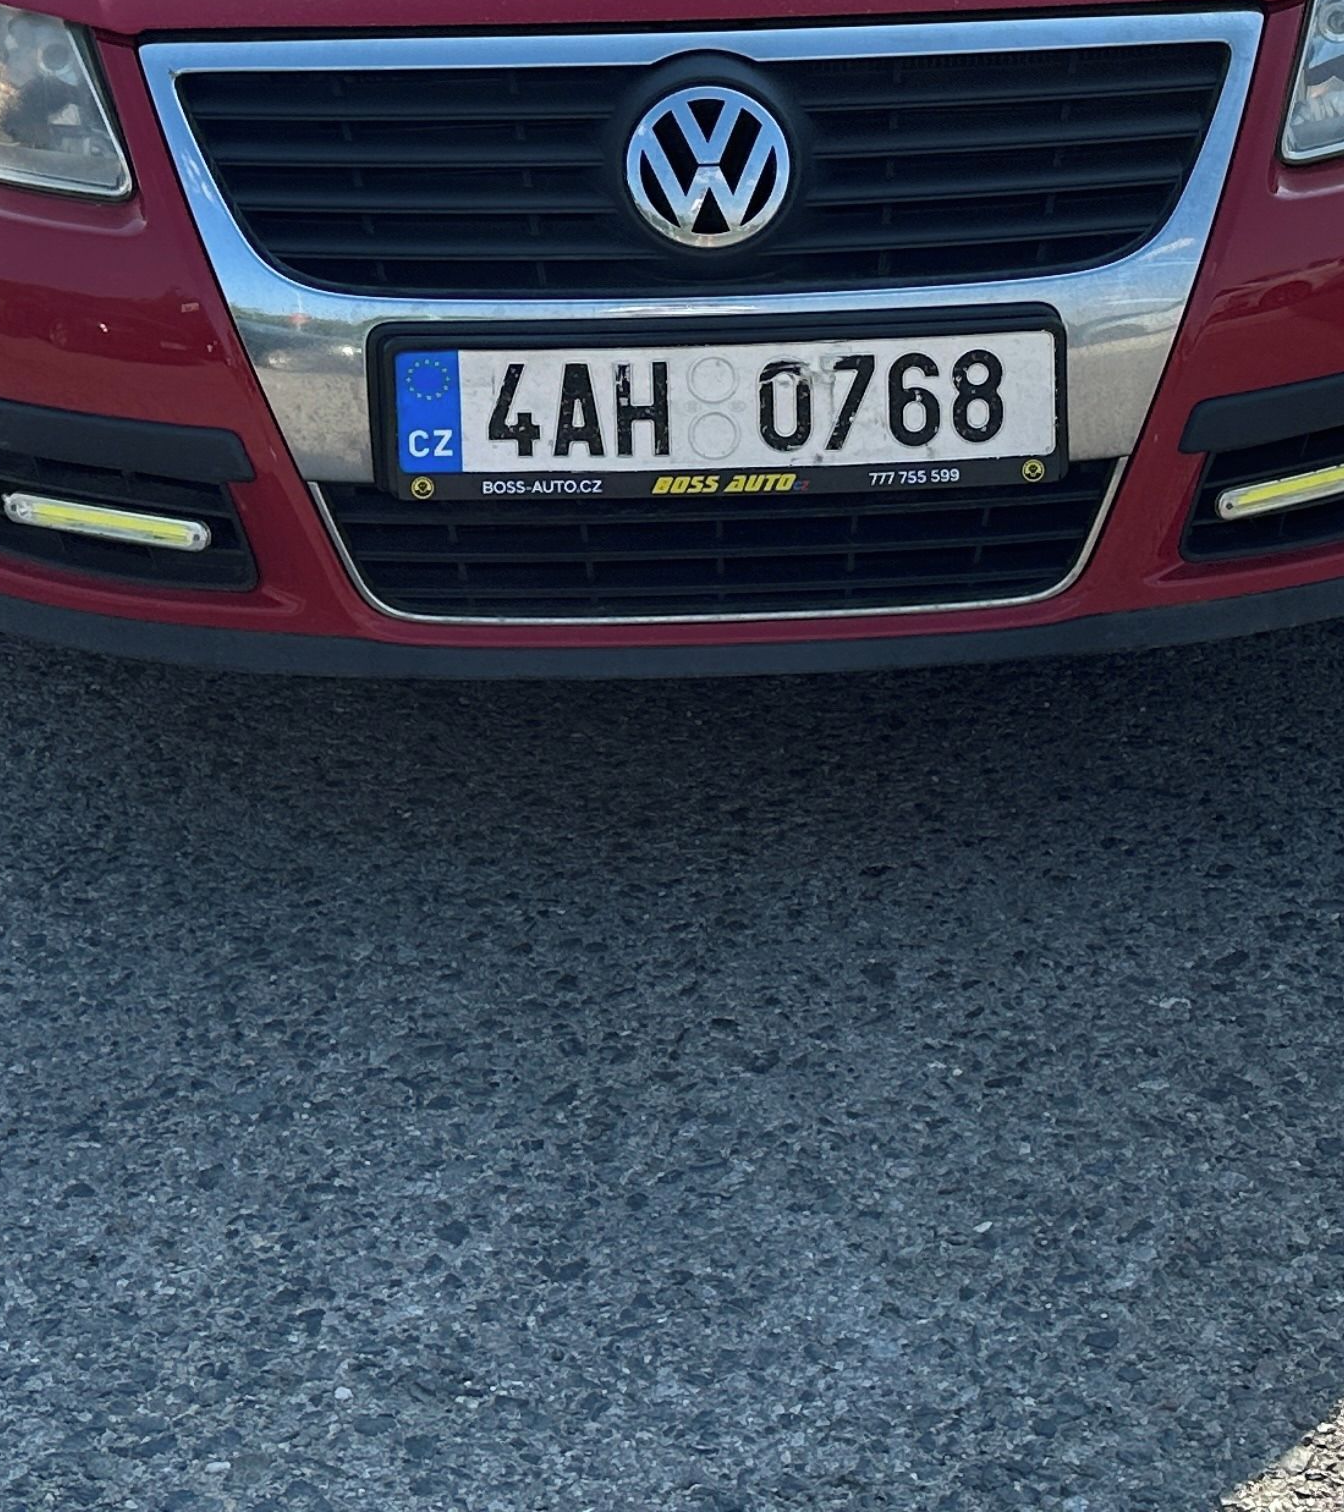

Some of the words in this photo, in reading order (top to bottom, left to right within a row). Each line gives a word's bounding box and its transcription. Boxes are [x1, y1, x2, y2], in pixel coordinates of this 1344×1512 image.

[488, 361, 670, 458] 4AH
[758, 349, 1004, 452] 0768
[408, 429, 454, 458] CZ
[482, 480, 602, 494] BOSS-AUTO.CZ
[652, 475, 720, 494] BOSS
[723, 473, 796, 492] AUTO
[868, 471, 895, 486] 777
[898, 470, 927, 484] 755
[930, 468, 960, 483] 599
